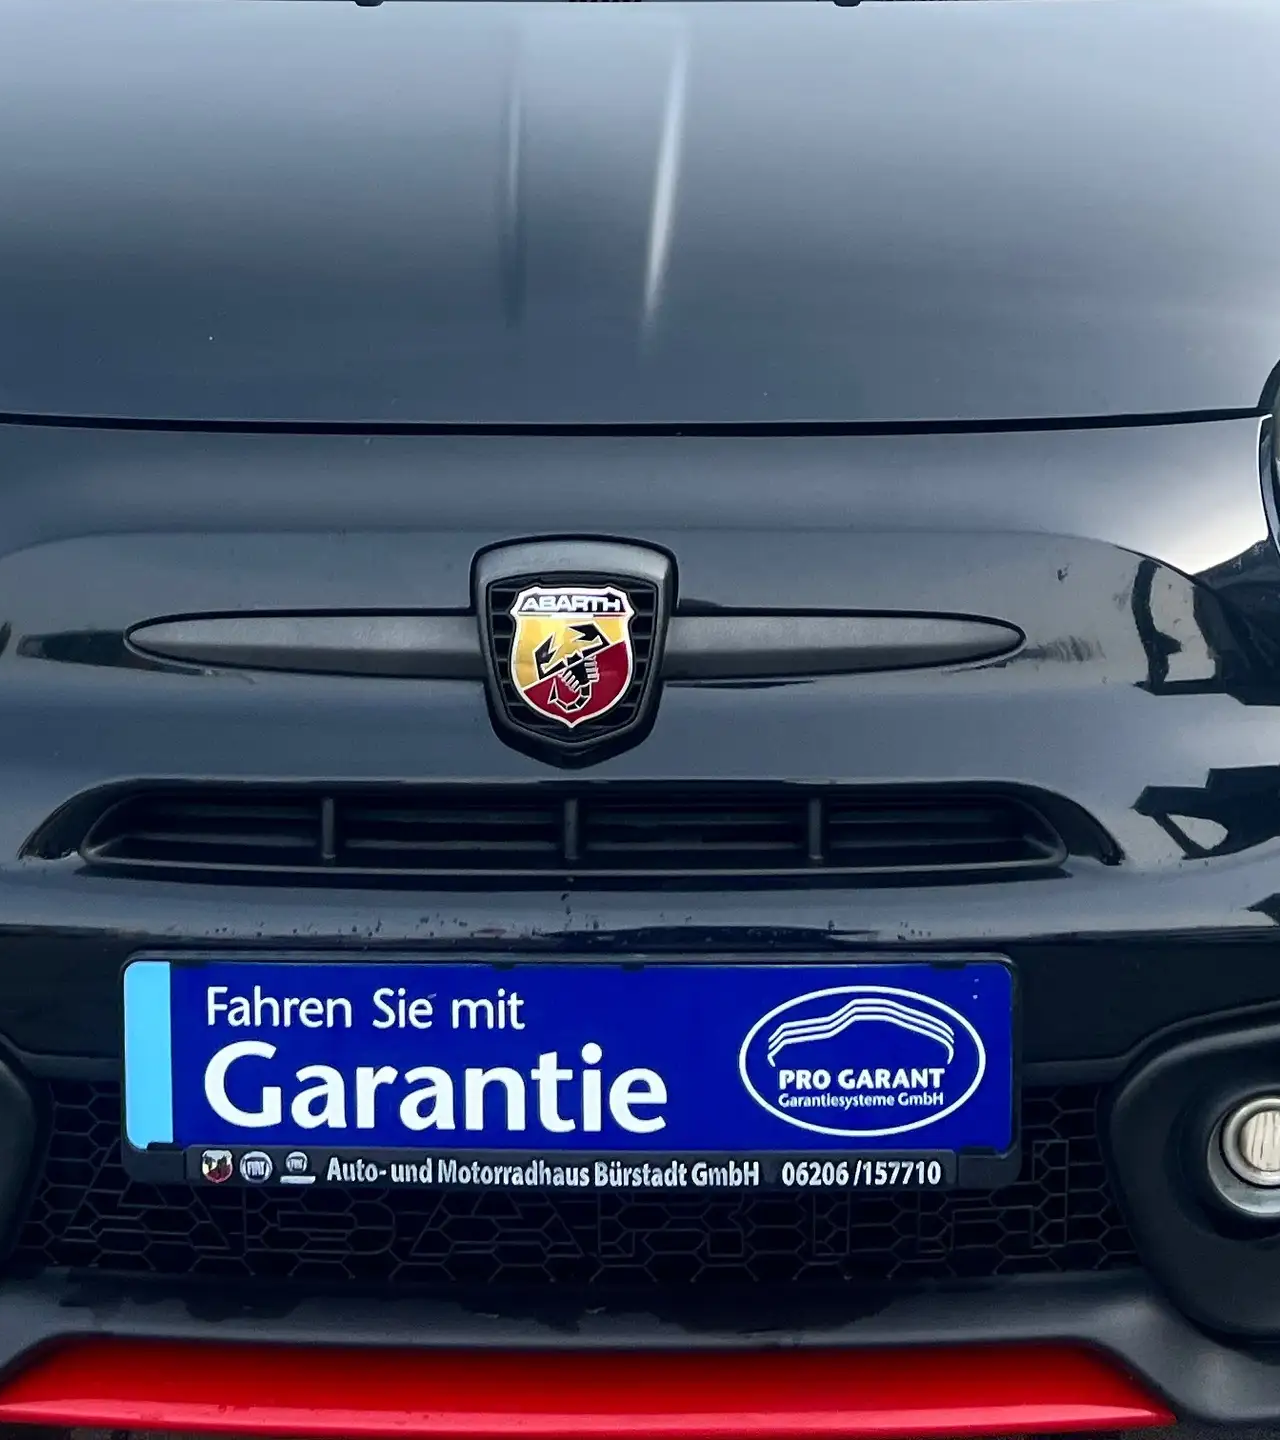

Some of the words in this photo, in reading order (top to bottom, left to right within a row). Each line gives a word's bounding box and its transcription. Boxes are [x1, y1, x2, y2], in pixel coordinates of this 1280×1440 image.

[521, 595, 621, 611] ABARTH
[207, 985, 352, 1028] Fahren
[372, 987, 433, 1029] Sie
[451, 988, 526, 1030] mit
[204, 1040, 668, 1134] Garantie
[779, 1069, 832, 1090] PRO
[837, 1067, 946, 1090] GARANT
[777, 1092, 895, 1111] Garantiesysteme
[897, 1091, 945, 1107] GmbH
[326, 1157, 387, 1182] Auto-
[390, 1157, 433, 1184] und
[437, 1159, 590, 1187] Motorradhaus
[594, 1160, 688, 1187] Bürstadt
[691, 1160, 760, 1187] GmbH
[781, 1161, 850, 1187] 06206
[853, 1159, 942, 1187] /157710
